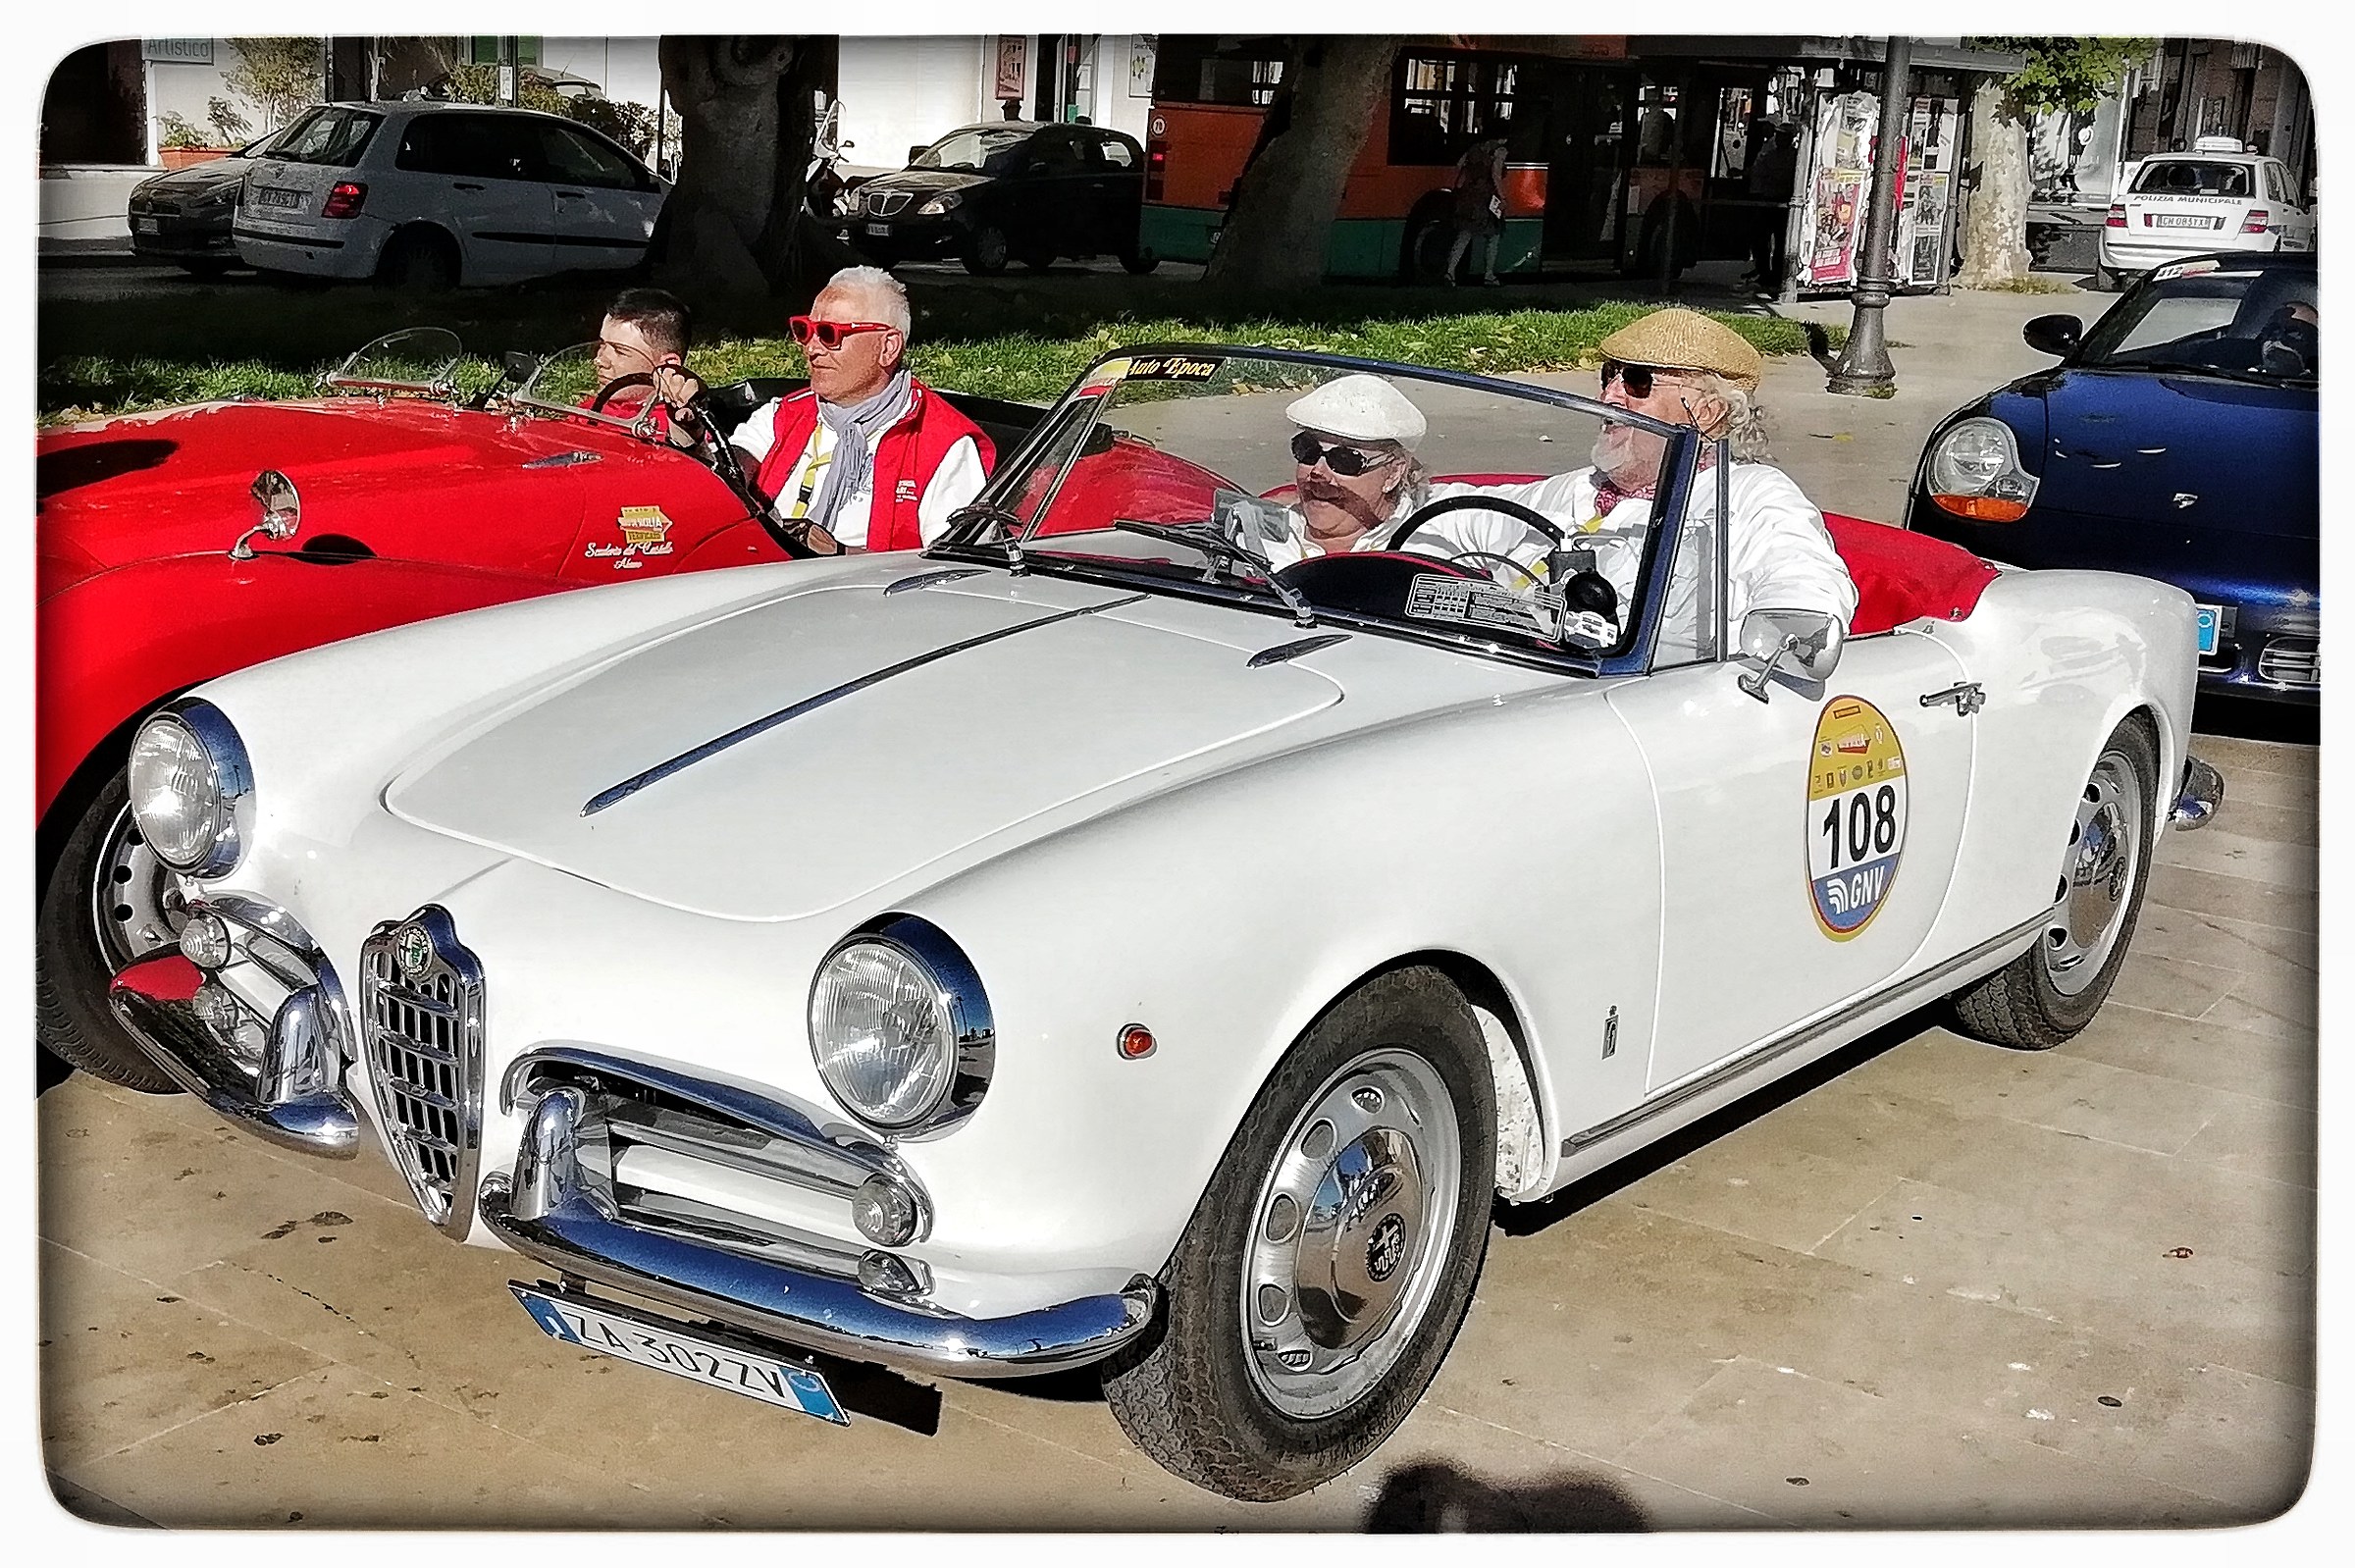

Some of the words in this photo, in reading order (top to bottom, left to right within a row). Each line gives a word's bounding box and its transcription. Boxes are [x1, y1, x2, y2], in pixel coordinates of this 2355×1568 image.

[147, 38, 209, 58] Artistico
[2176, 195, 2242, 206] MUNICIPALE
[1128, 359, 1160, 376] Auto
[1822, 784, 1896, 869] 108
[1851, 865, 1885, 909] GNV
[561, 1311, 632, 1353] ZA
